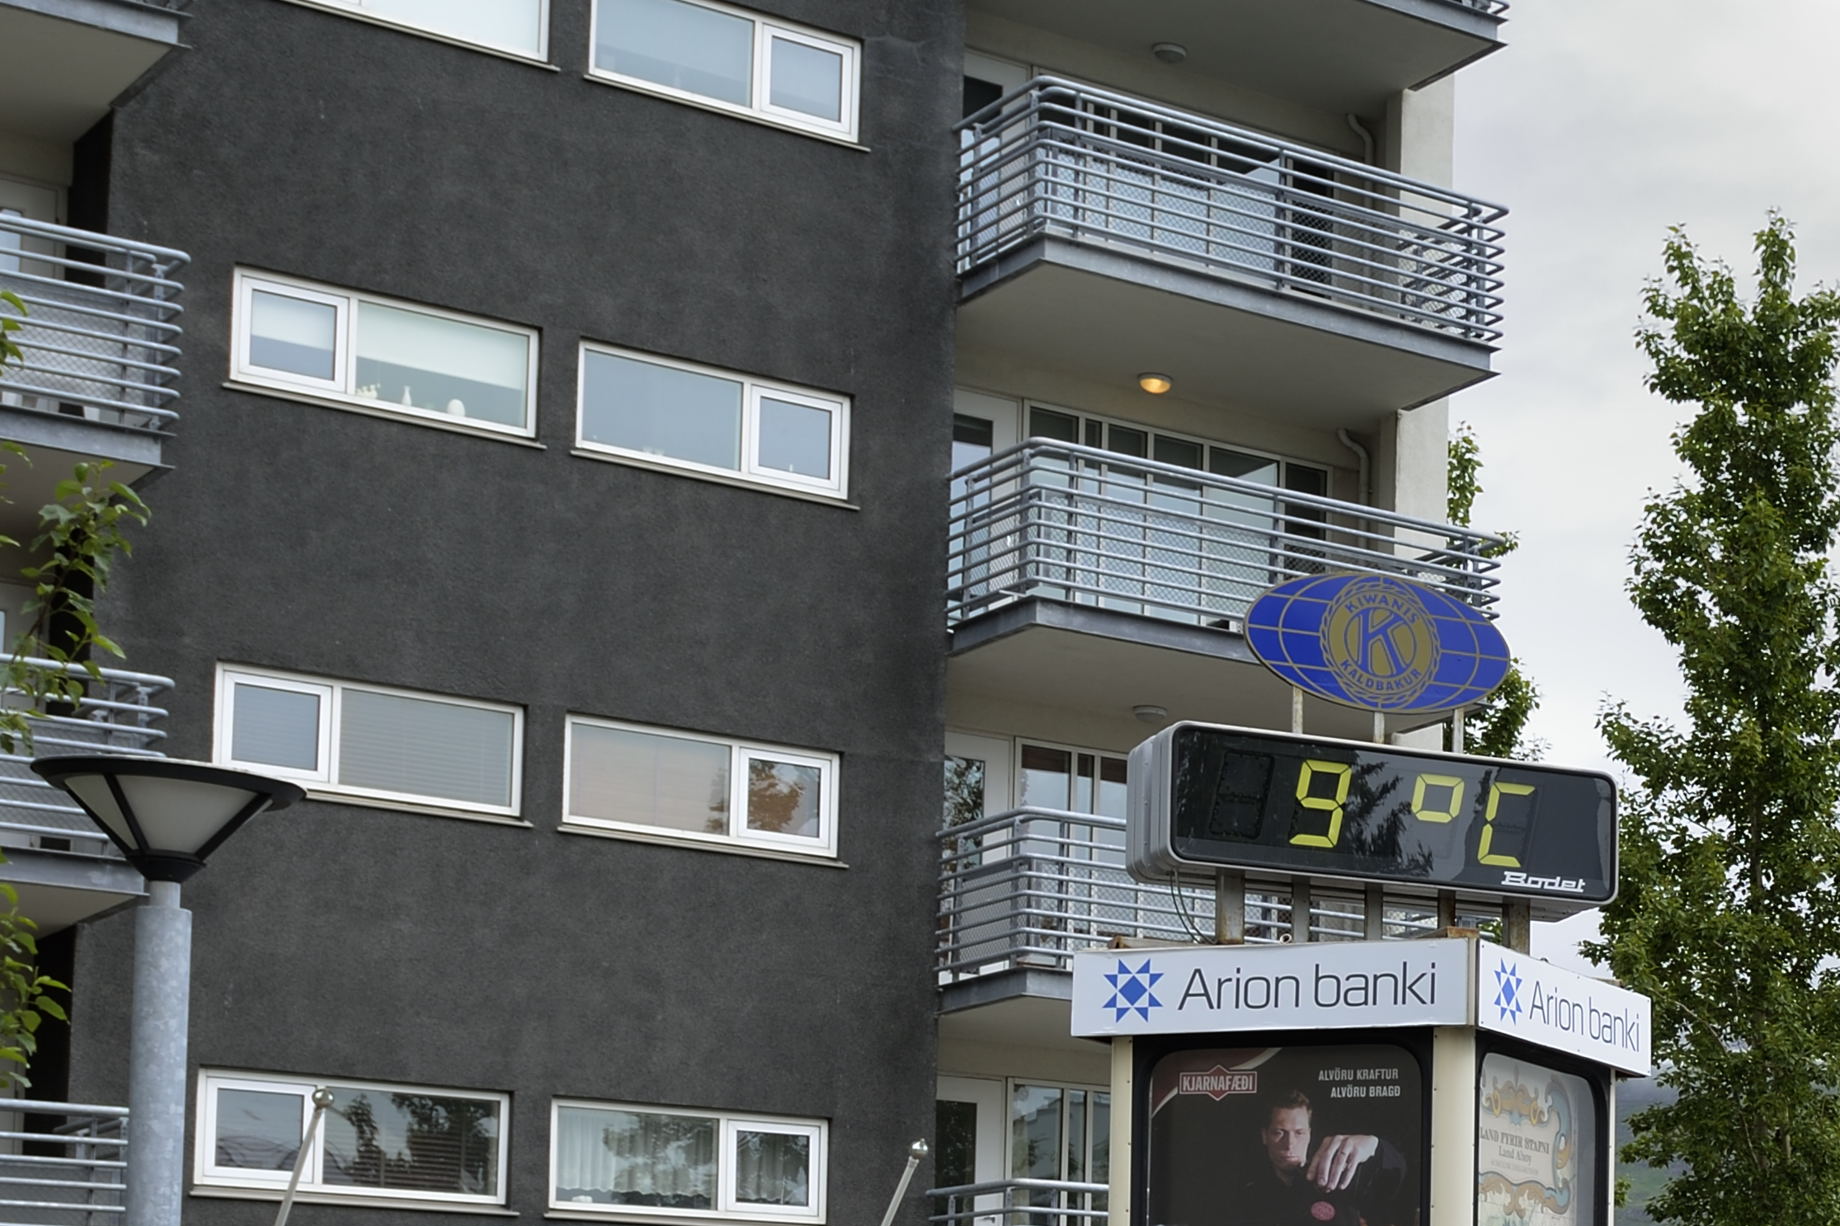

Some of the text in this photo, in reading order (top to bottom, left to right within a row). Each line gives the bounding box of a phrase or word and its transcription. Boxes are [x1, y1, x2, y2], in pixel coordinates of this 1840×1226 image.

[1345, 594, 1419, 625] KIWANIS
[1340, 659, 1421, 692] KALDBAKUR
[1501, 870, 1586, 893] Bodet
[1177, 961, 1437, 1011] Arion banki
[1529, 981, 1640, 1053] Arion banki
[1182, 1076, 1253, 1091] KJARNAFÆÐI
[1318, 1068, 1399, 1081] ALVÖRU KRAFTUR
[1330, 1086, 1401, 1098] ALVÖRU BRAGÐ
